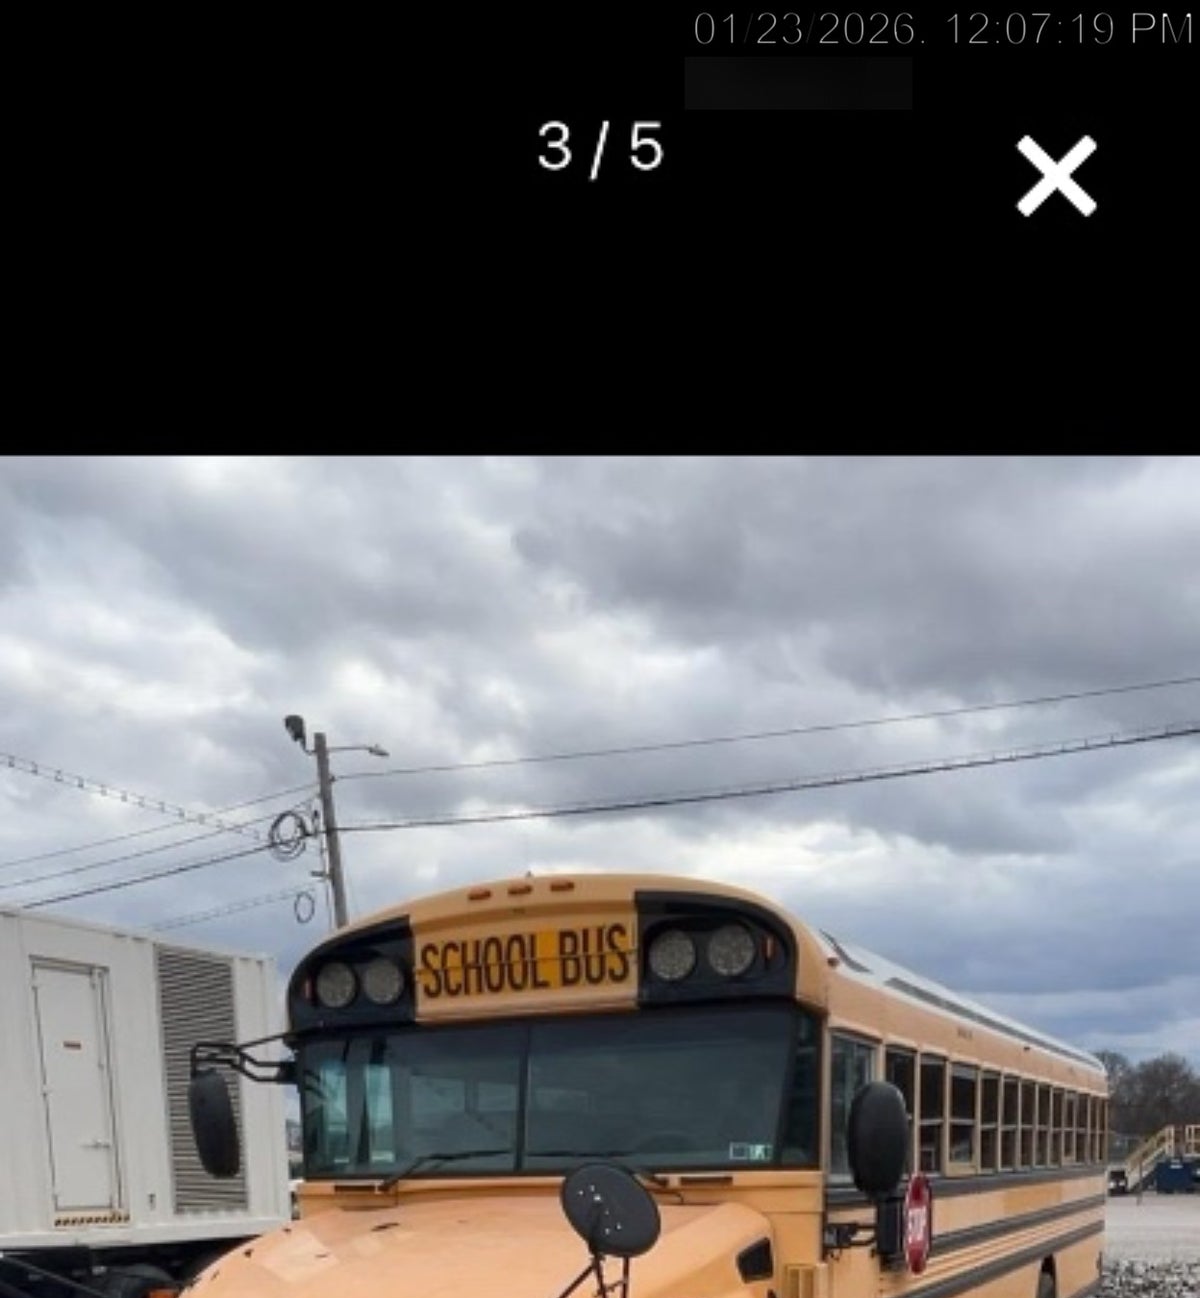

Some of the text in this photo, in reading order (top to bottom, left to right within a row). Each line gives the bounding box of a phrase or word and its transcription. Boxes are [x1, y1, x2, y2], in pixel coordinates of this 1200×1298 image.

[421, 923, 630, 998] SCHOOL BUS
[908, 1205, 927, 1245] STOP
